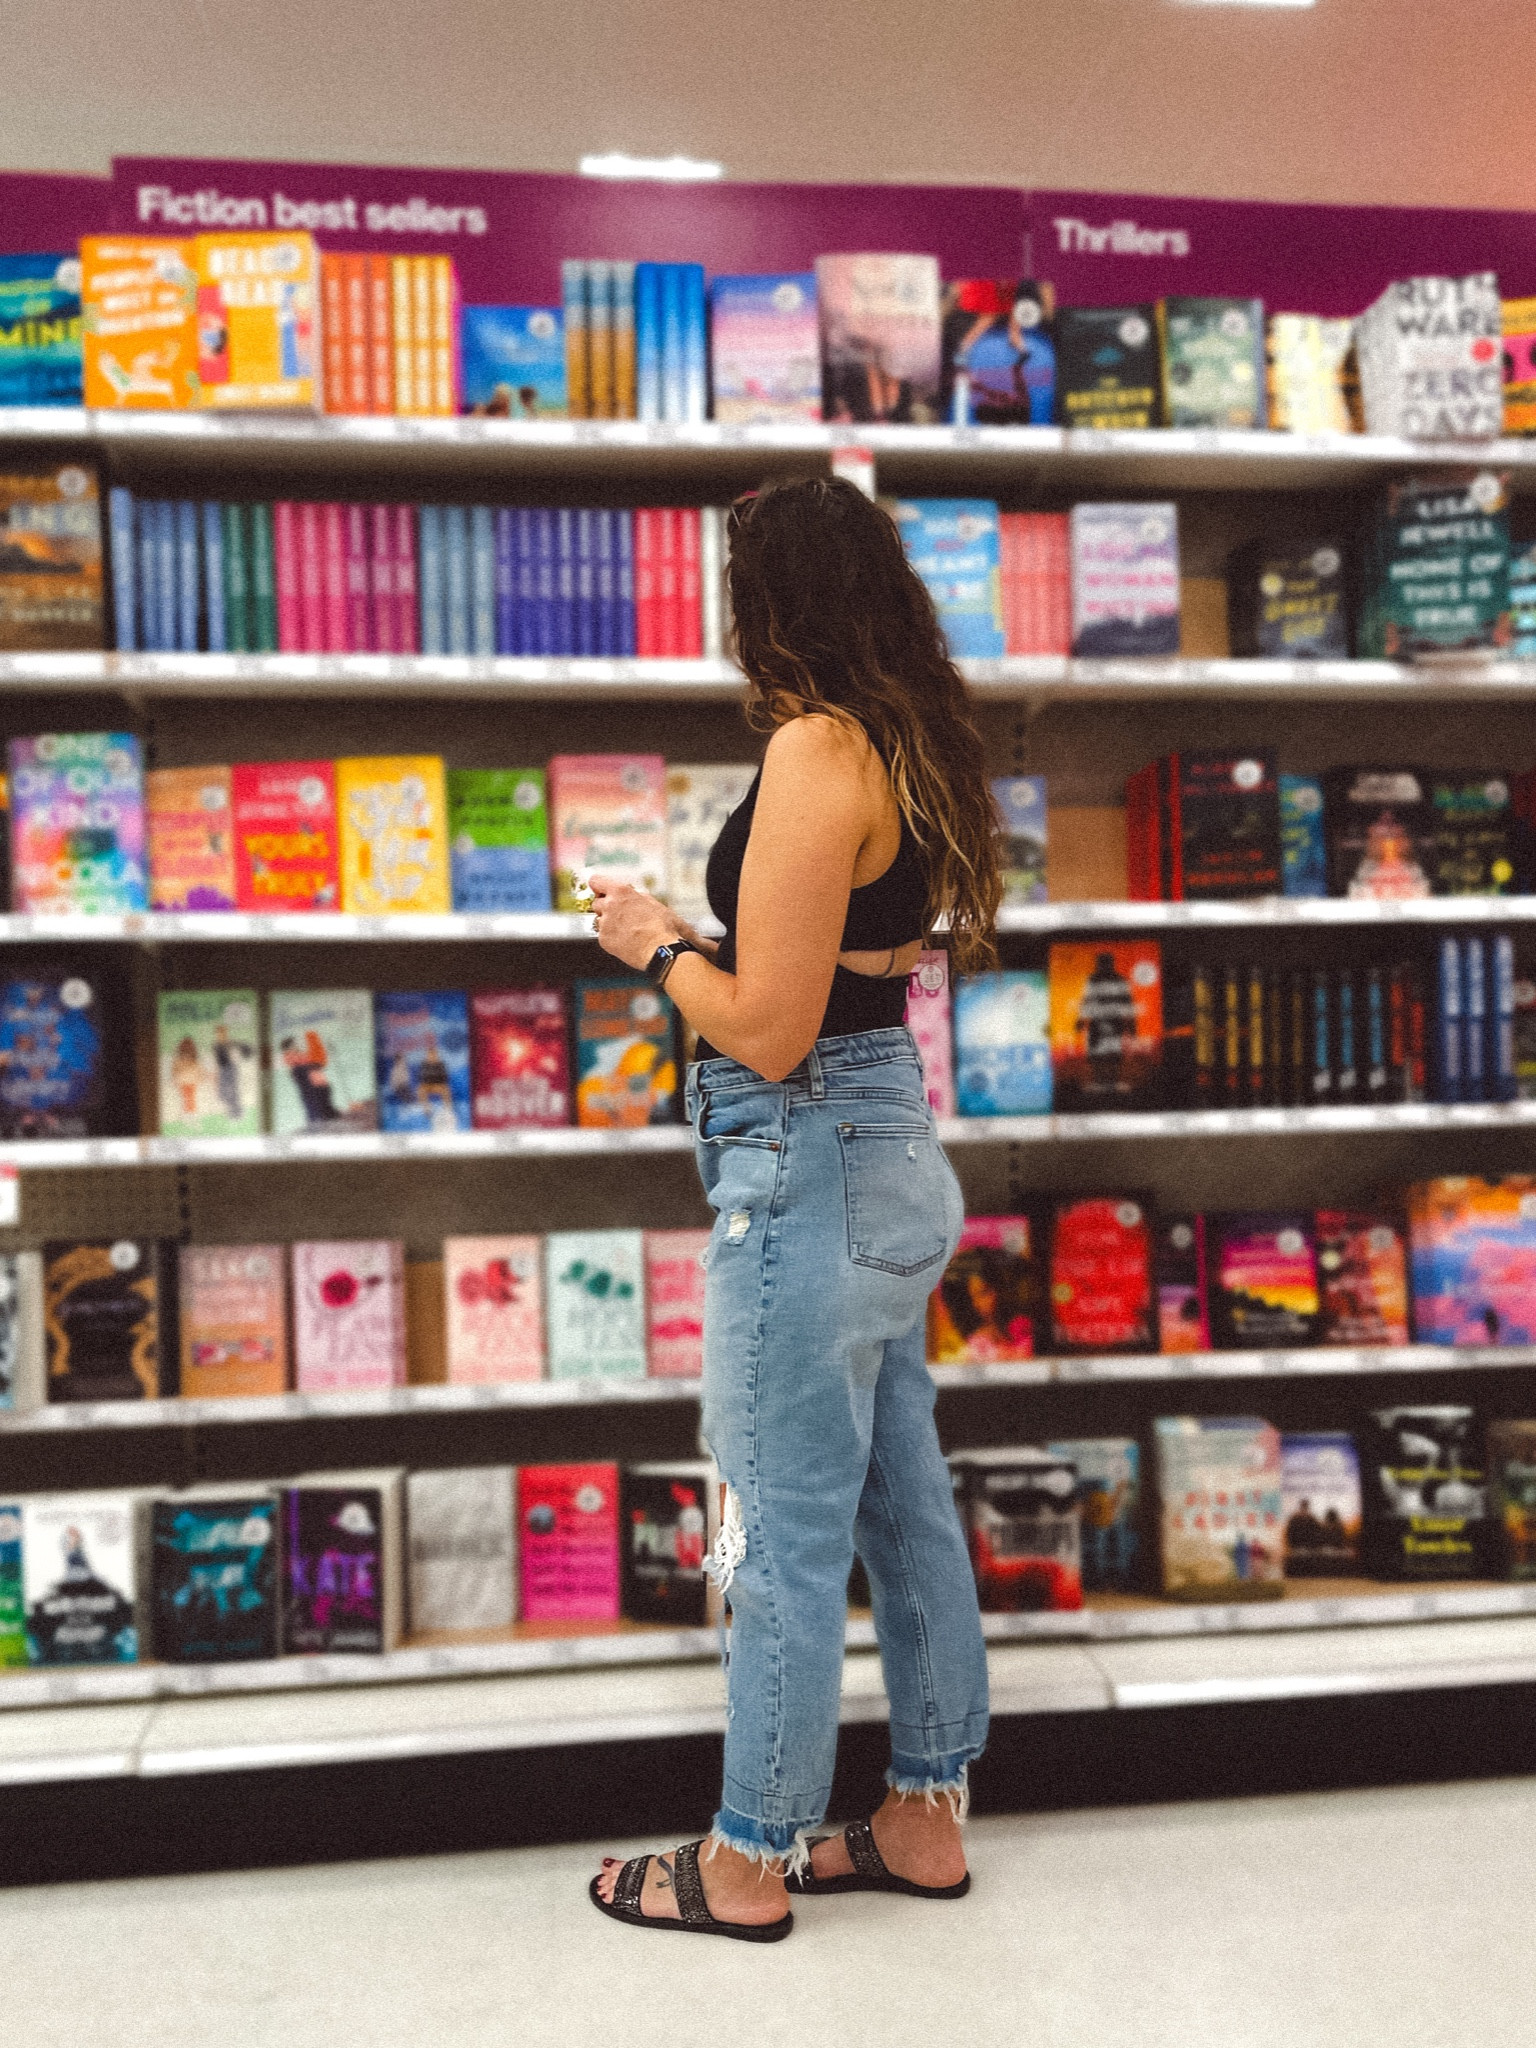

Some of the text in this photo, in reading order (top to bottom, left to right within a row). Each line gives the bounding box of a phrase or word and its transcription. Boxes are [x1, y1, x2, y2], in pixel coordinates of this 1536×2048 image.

[138, 185, 487, 235] Fiction best sellers
[1053, 217, 1190, 256] Thrillers
[1401, 522, 1494, 545] JEWELL
[1403, 582, 1460, 604] THIS
[1414, 606, 1477, 627] TRUE
[14, 767, 59, 798] OF
